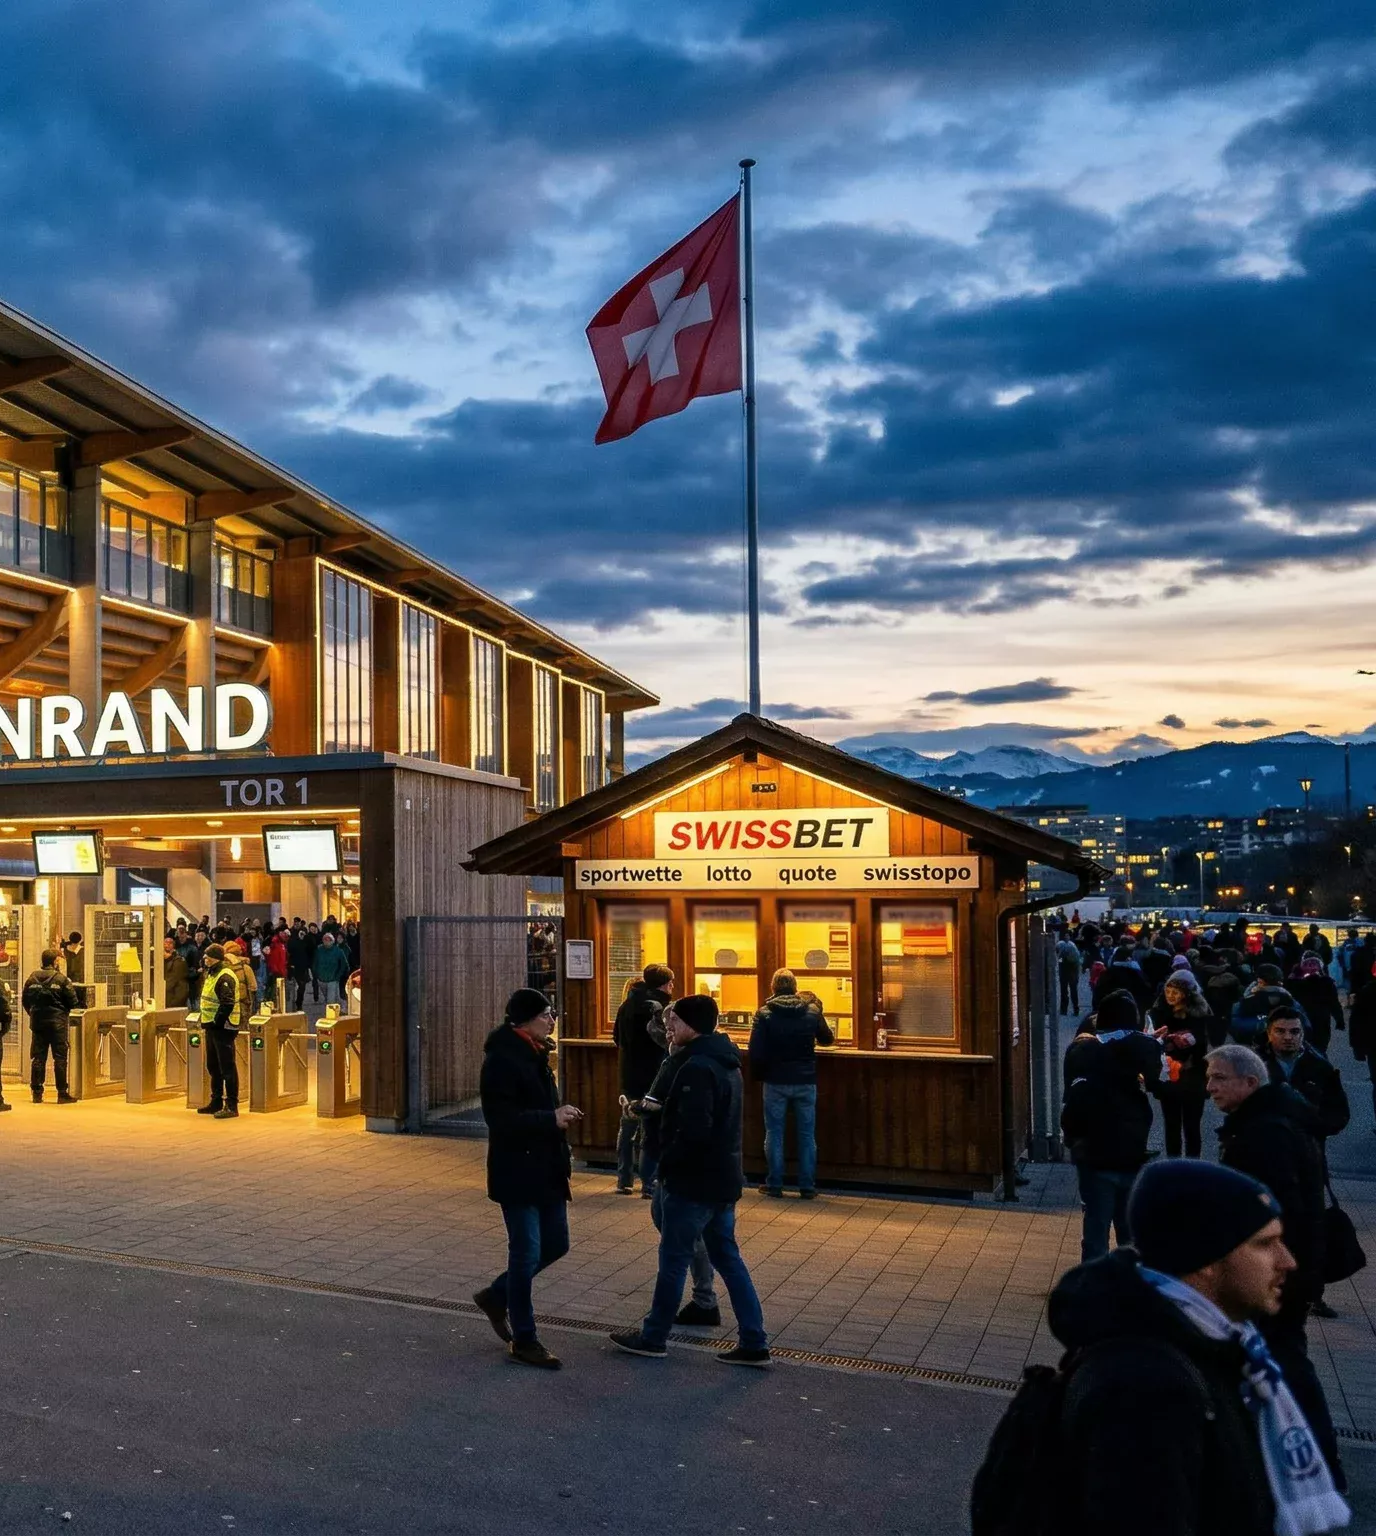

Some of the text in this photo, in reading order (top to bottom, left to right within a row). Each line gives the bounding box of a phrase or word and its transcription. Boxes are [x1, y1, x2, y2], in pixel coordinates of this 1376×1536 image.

[220, 777, 308, 806] TOR 1
[667, 818, 874, 851] SWISSBET
[580, 864, 972, 886] sportwette lotto quote swisstopo
